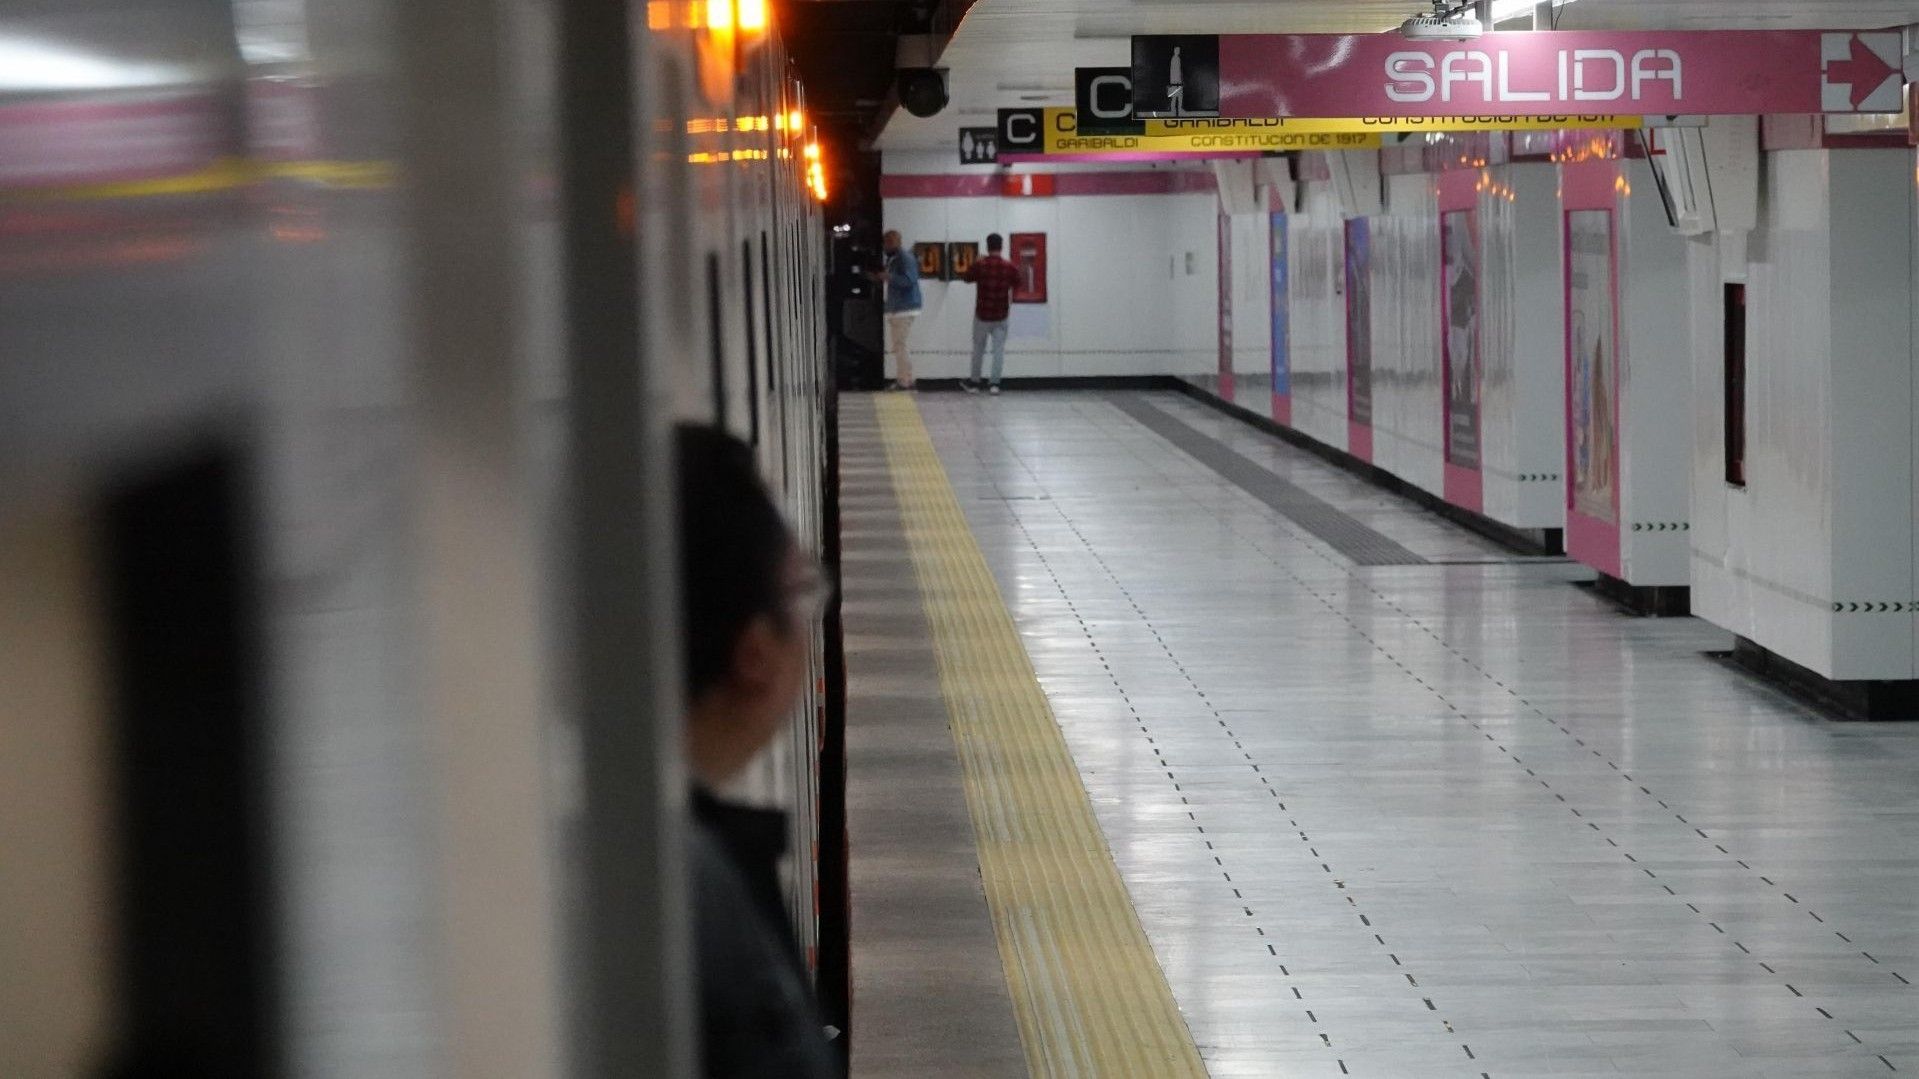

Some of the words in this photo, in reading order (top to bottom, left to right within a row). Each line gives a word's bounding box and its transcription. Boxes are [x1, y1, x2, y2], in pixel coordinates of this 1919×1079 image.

[1385, 50, 1682, 102] SALIDA
[1091, 75, 1132, 118] C
[1008, 113, 1036, 143] C
[1056, 138, 1138, 150] GARIBALDI
